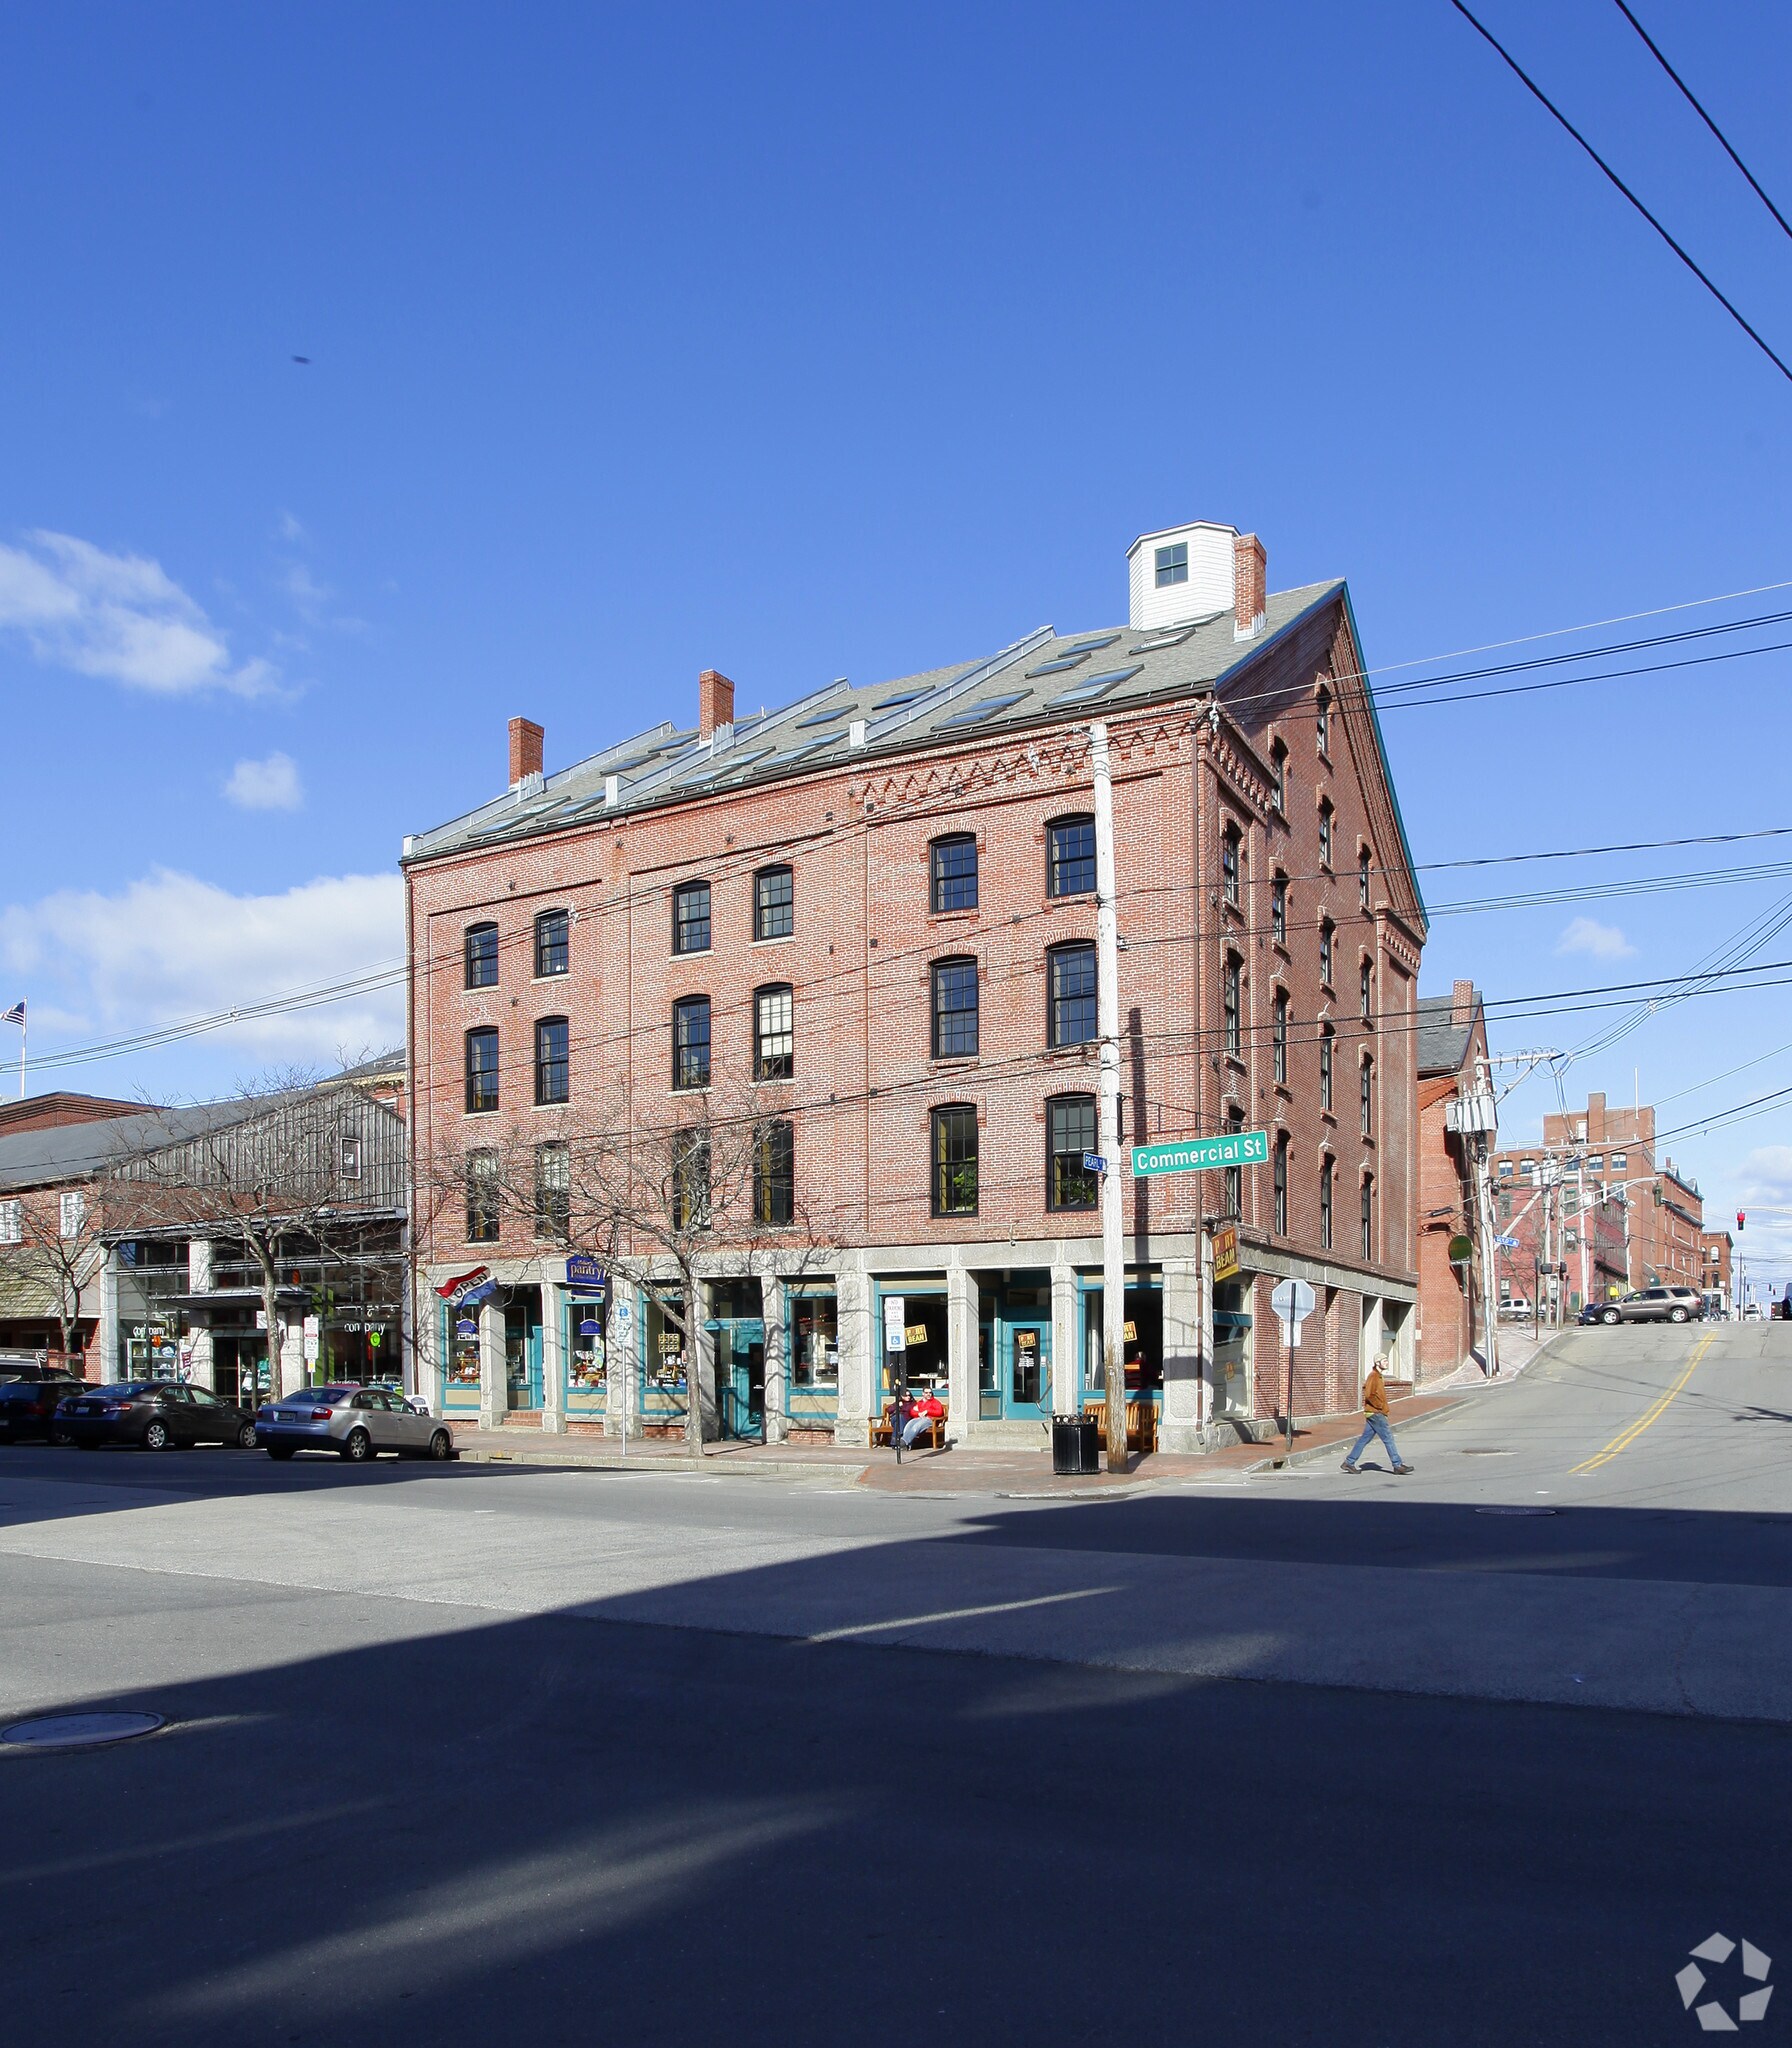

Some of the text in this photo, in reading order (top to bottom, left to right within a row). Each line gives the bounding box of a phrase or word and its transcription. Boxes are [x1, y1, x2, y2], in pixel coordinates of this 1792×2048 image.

[1085, 1155, 1100, 1169] PEARL
[1137, 1138, 1262, 1170] Commercial St
[1216, 1247, 1235, 1270] BEAN
[570, 1264, 602, 1281] pantry
[454, 1272, 487, 1298] OPEN
[908, 1333, 925, 1343] BEAN
